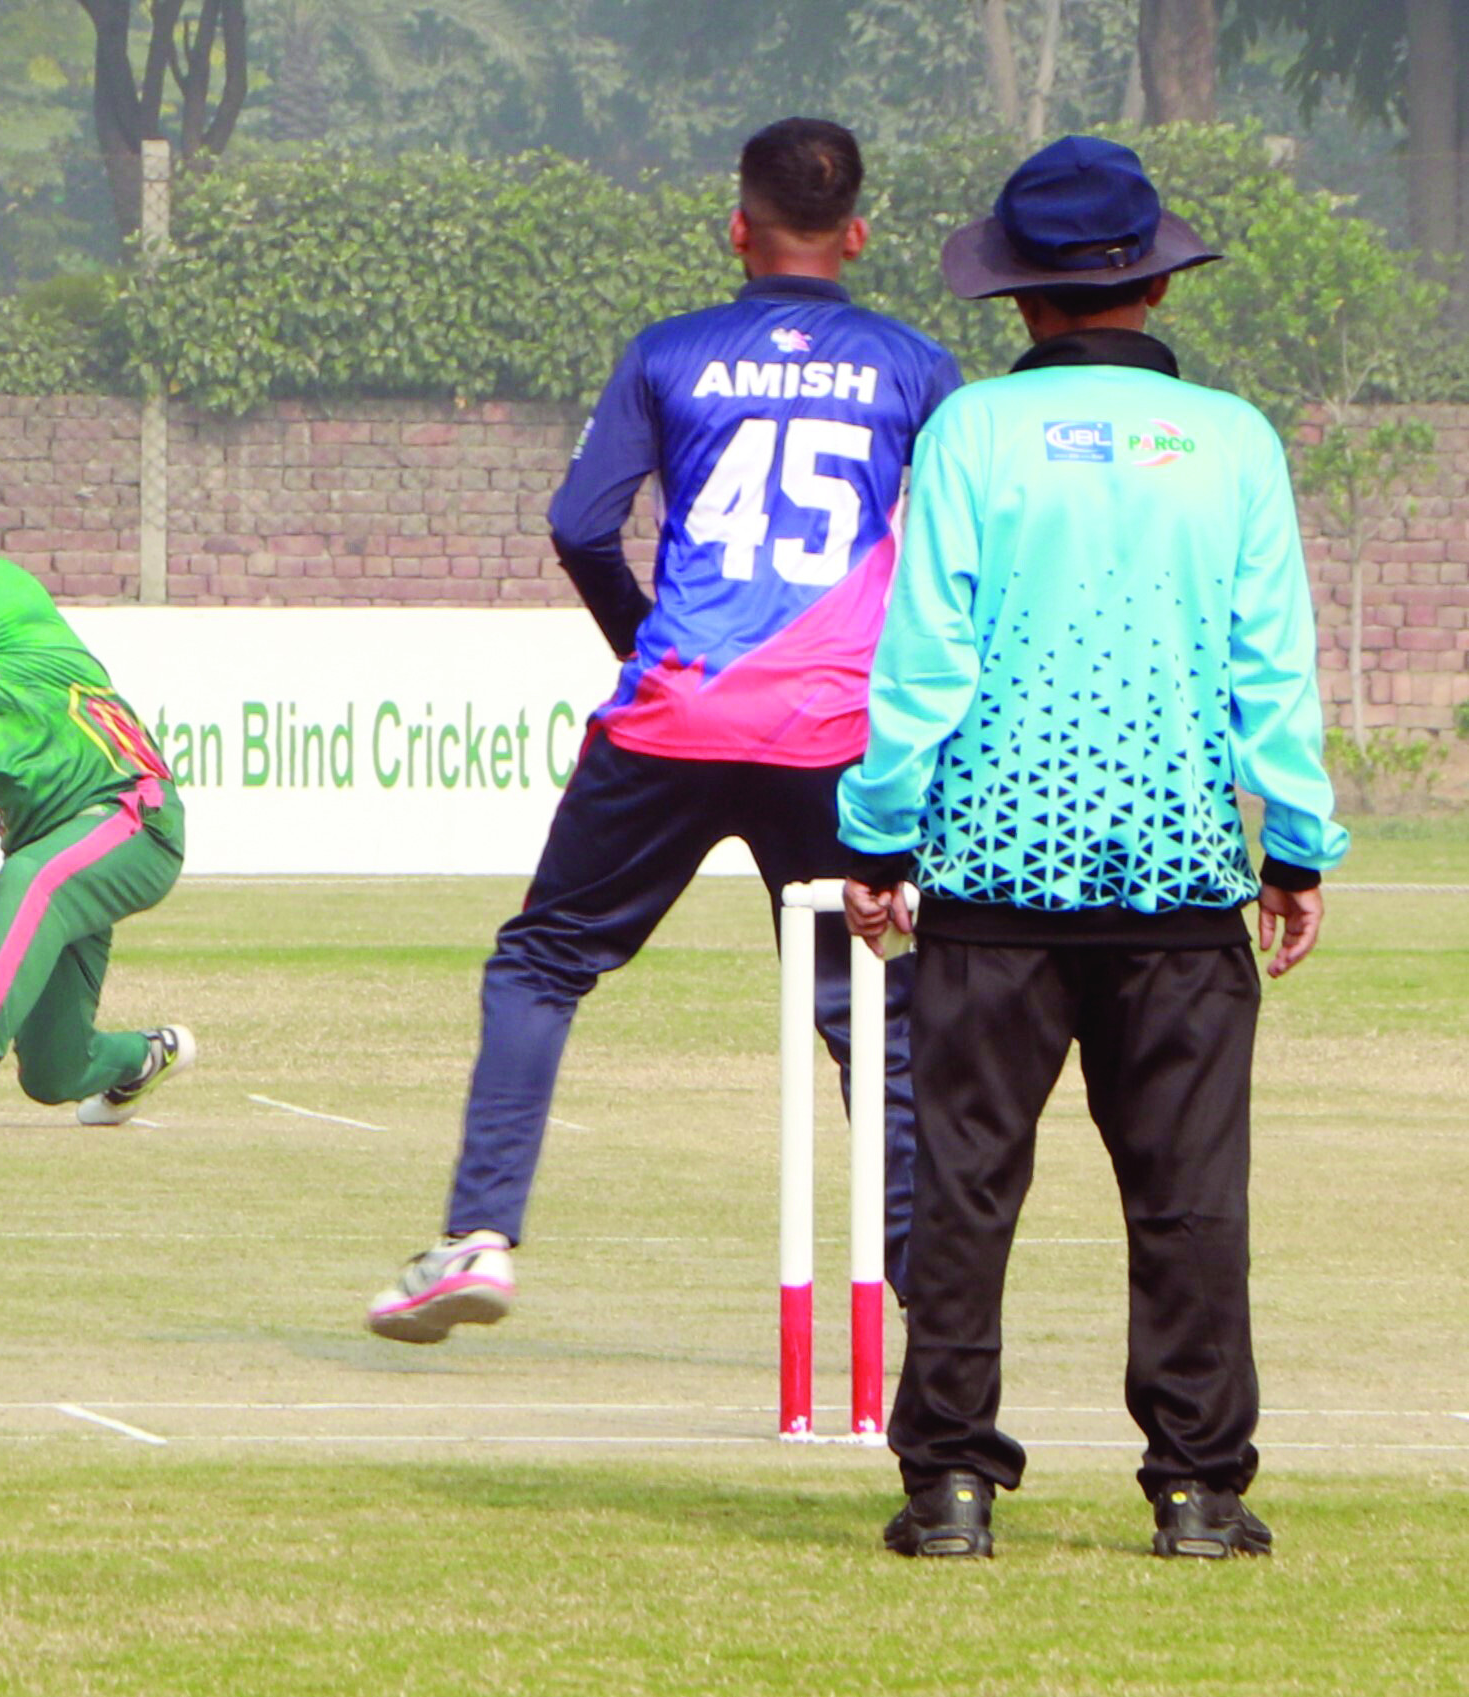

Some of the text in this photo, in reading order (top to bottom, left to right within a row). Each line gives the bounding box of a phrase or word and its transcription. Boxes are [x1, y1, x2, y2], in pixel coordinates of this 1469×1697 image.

[691, 360, 879, 405] AMISH
[1053, 428, 1113, 448] UBL
[1128, 434, 1197, 453] PARCO
[683, 417, 874, 587] 45
[242, 701, 355, 789] Blind
[372, 700, 531, 789] Cricket
